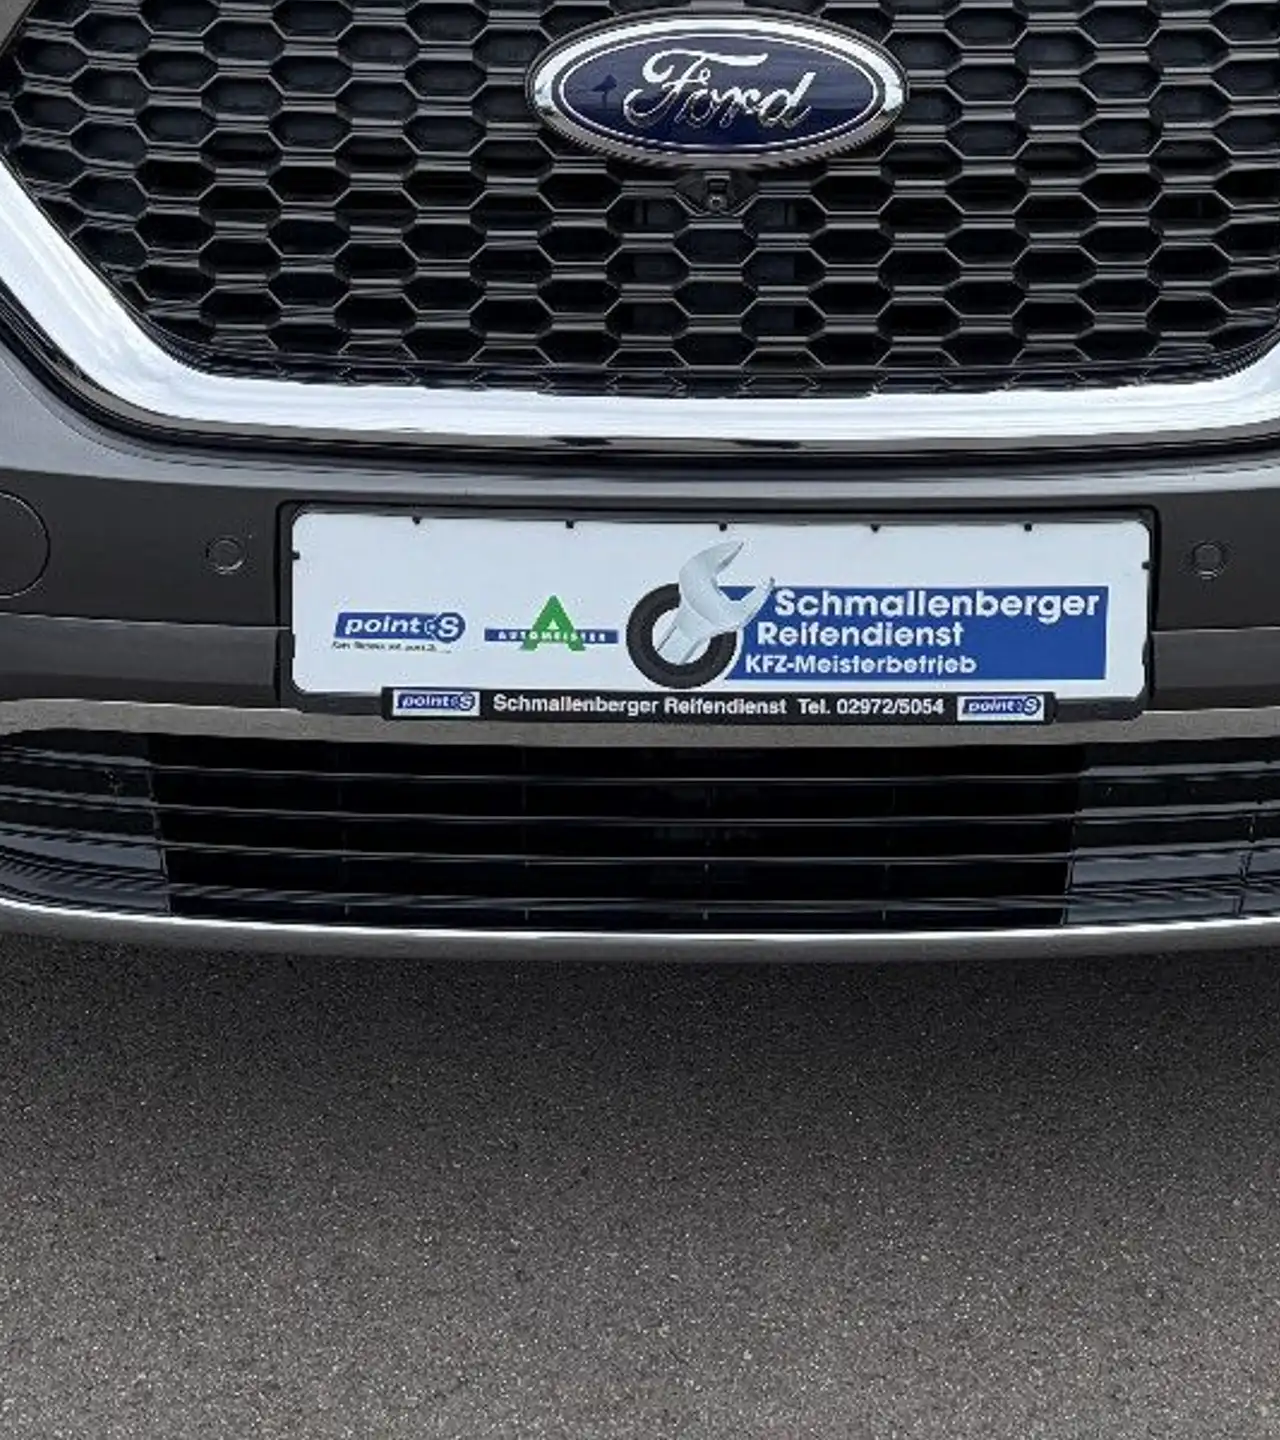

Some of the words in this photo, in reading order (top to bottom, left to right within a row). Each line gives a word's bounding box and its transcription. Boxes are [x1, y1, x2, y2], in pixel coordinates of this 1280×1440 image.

[623, 48, 817, 129] Ford
[774, 589, 1100, 624] Schmallenberger
[756, 621, 965, 647] Reifendienst
[744, 654, 978, 677] KFZ-Meisterbetrieb
[492, 693, 658, 716] Schmallenberger
[663, 696, 788, 716] Reifendienst
[797, 698, 831, 715] Tel.
[836, 698, 946, 715] 02972/5054
